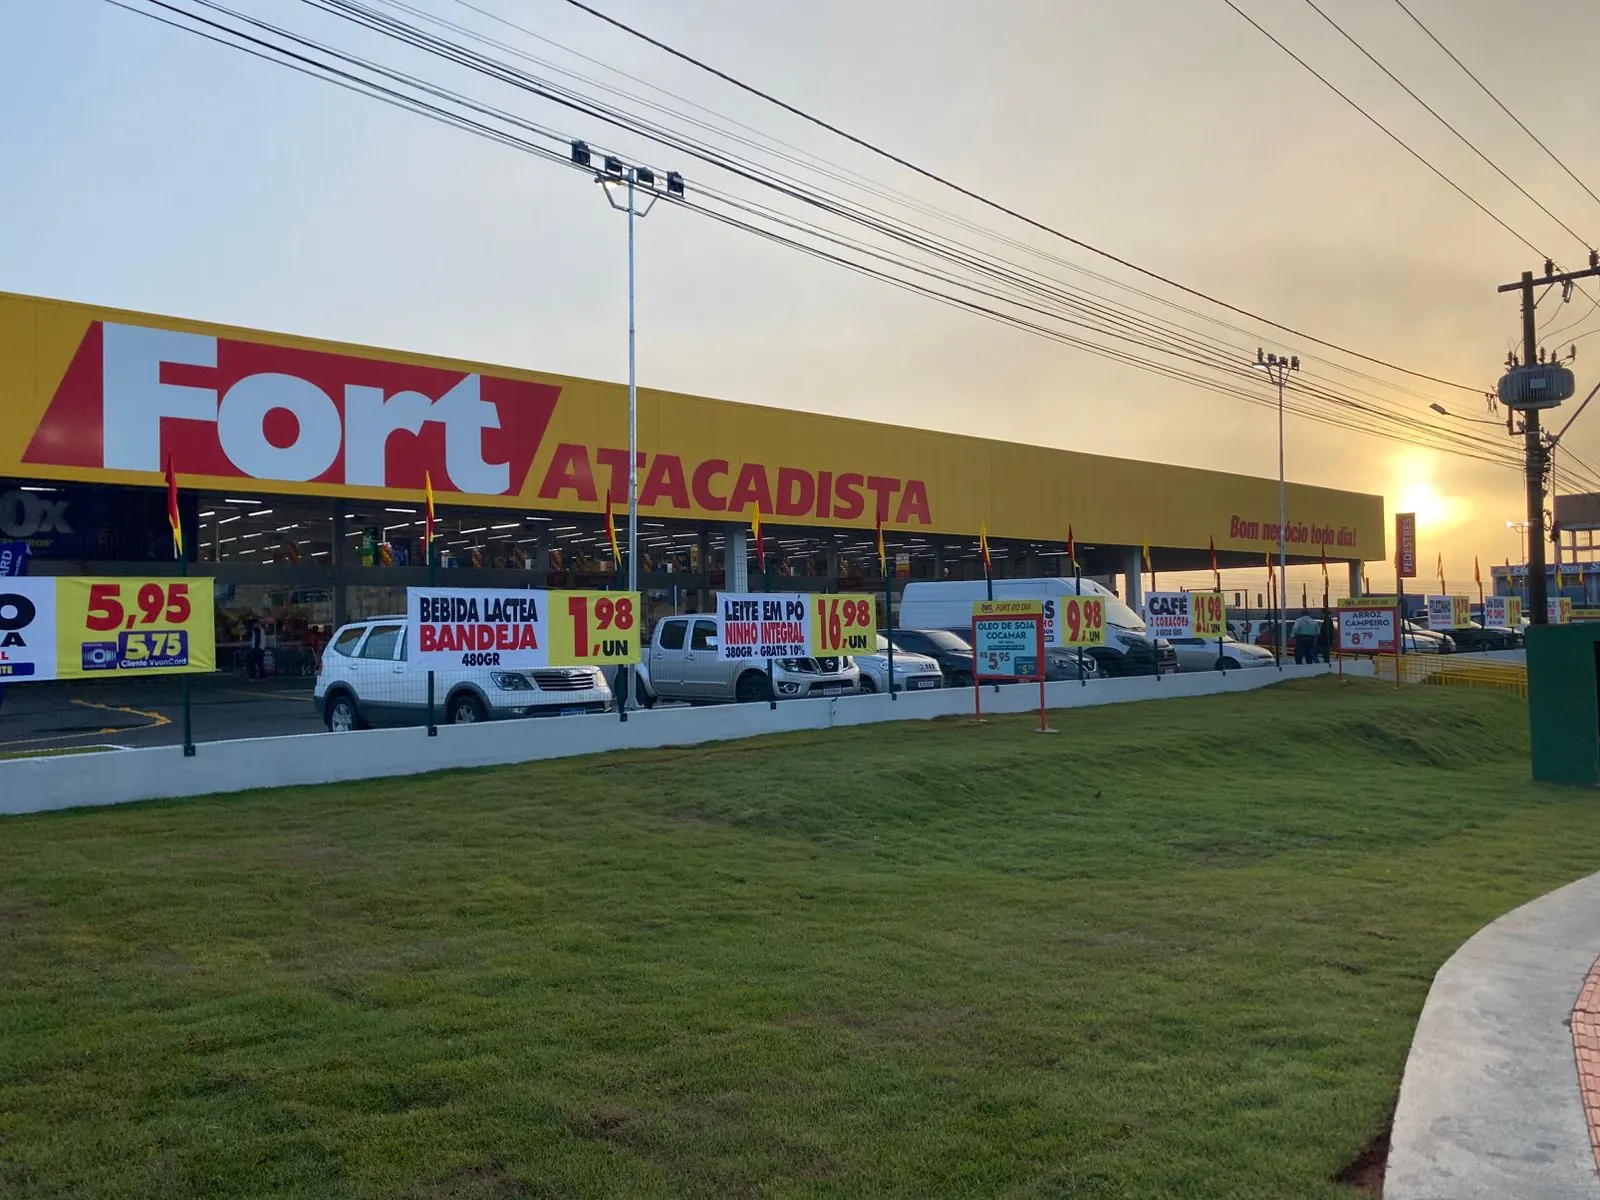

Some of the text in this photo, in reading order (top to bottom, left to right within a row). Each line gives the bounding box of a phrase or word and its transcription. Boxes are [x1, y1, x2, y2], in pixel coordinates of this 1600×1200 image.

[103, 321, 510, 496] Fort
[537, 443, 932, 525] ATACADISTA
[1230, 515, 1357, 547] Bom negócio todo dia!
[86, 583, 191, 631] 5,95
[420, 597, 538, 623] BEBIDA LACTEA
[725, 595, 805, 621] LEITE EM PÓ
[1042, 600, 1055, 619] S
[1149, 594, 1188, 616] CAFÉ
[1352, 611, 1383, 619] ARROZ
[568, 596, 634, 657] 1,98
[602, 640, 628, 656] UN
[818, 599, 871, 650] 16,98
[848, 635, 867, 649] UN
[1001, 621, 1012, 630] DE
[1014, 621, 1035, 630] SOJA
[1066, 599, 1102, 642] 9,98 UN
[1345, 619, 1390, 627] CAMPEIRO
[419, 624, 538, 652] BANDEJA
[725, 622, 805, 645] NINHO INTEGRAL
[986, 631, 1026, 640] COCAMAR
[1351, 632, 1373, 646] 8,79
[124, 632, 182, 661] 5,75
[725, 646, 753, 658] 380GR
[760, 645, 788, 657] GRATIS
[789, 644, 806, 656] 10%
[121, 658, 187, 668] Cliente VuonCard
[461, 653, 501, 666] 480GR
[988, 651, 1010, 671] 5,95
